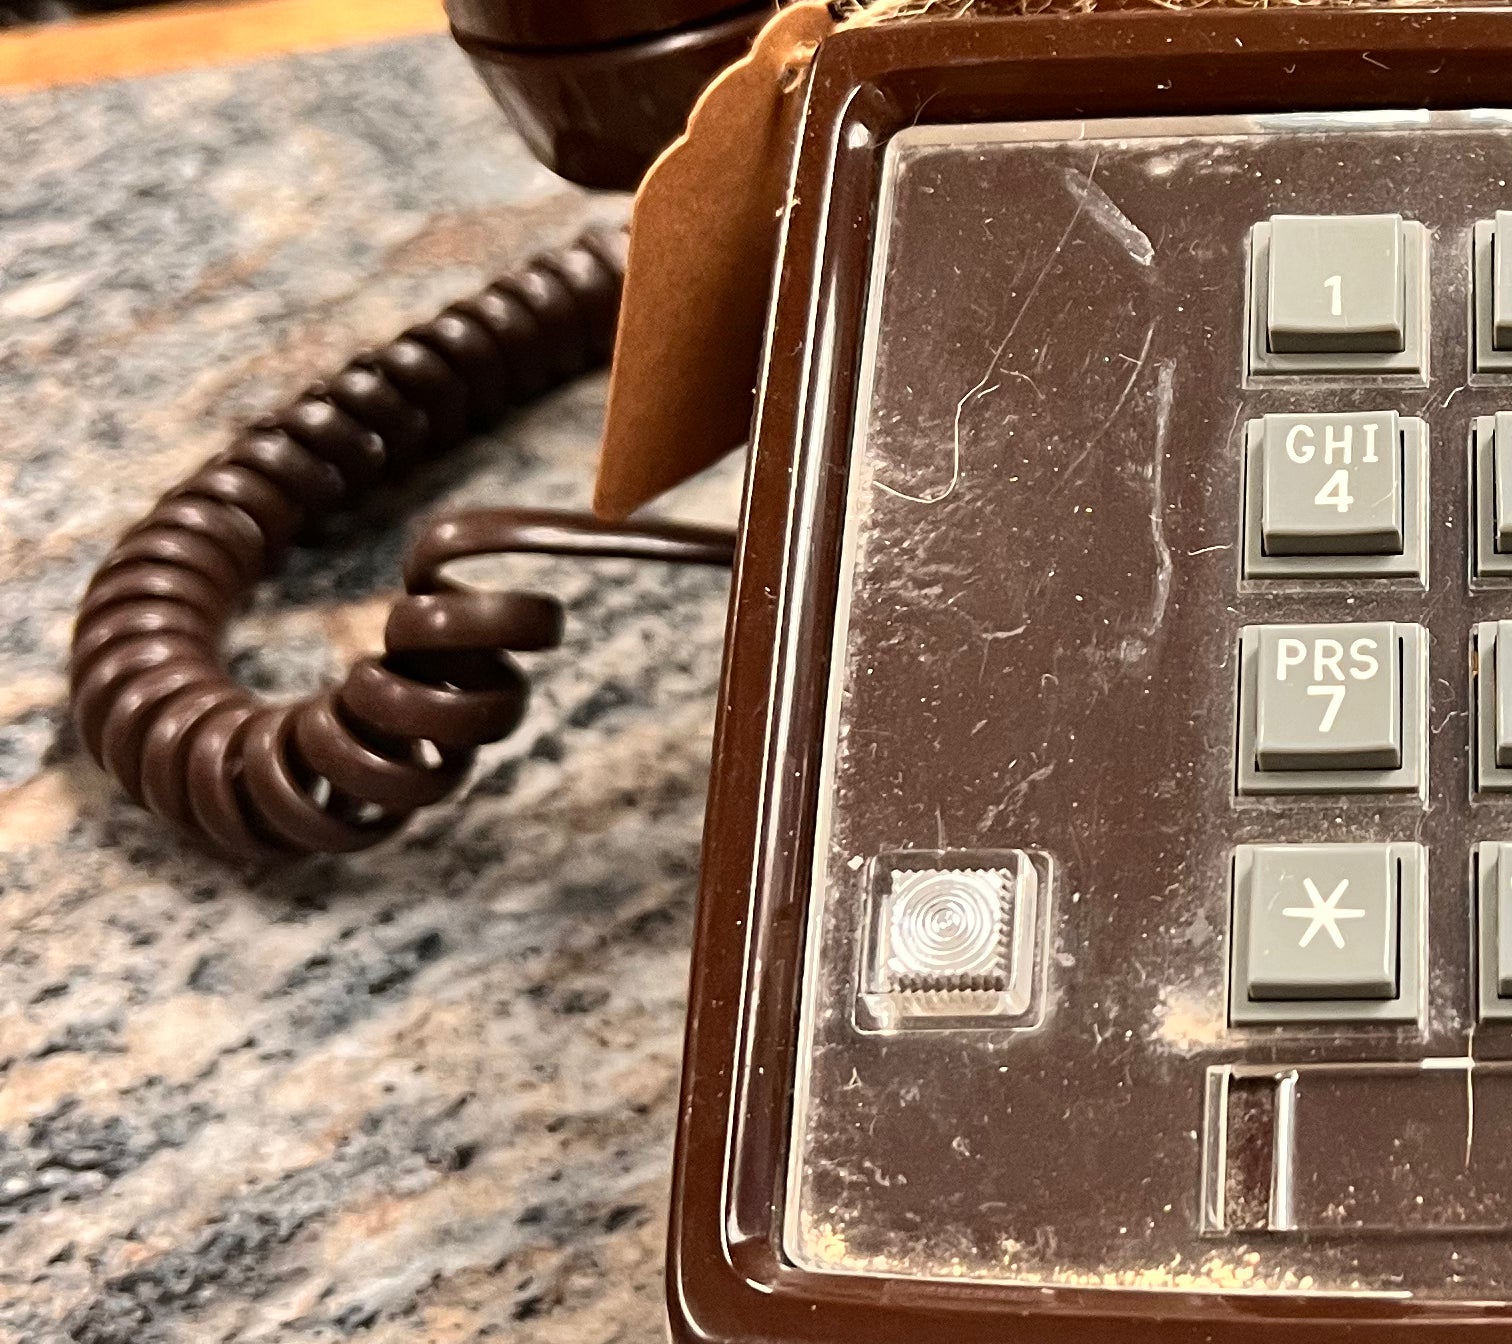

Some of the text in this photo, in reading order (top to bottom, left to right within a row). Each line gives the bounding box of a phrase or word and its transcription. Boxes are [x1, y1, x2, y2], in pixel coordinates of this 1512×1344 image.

[1324, 275, 1342, 316] 1
[1286, 424, 1379, 464] GHI
[1314, 470, 1354, 513] 4
[1276, 638, 1379, 681] PRS
[1306, 685, 1346, 733] 7
